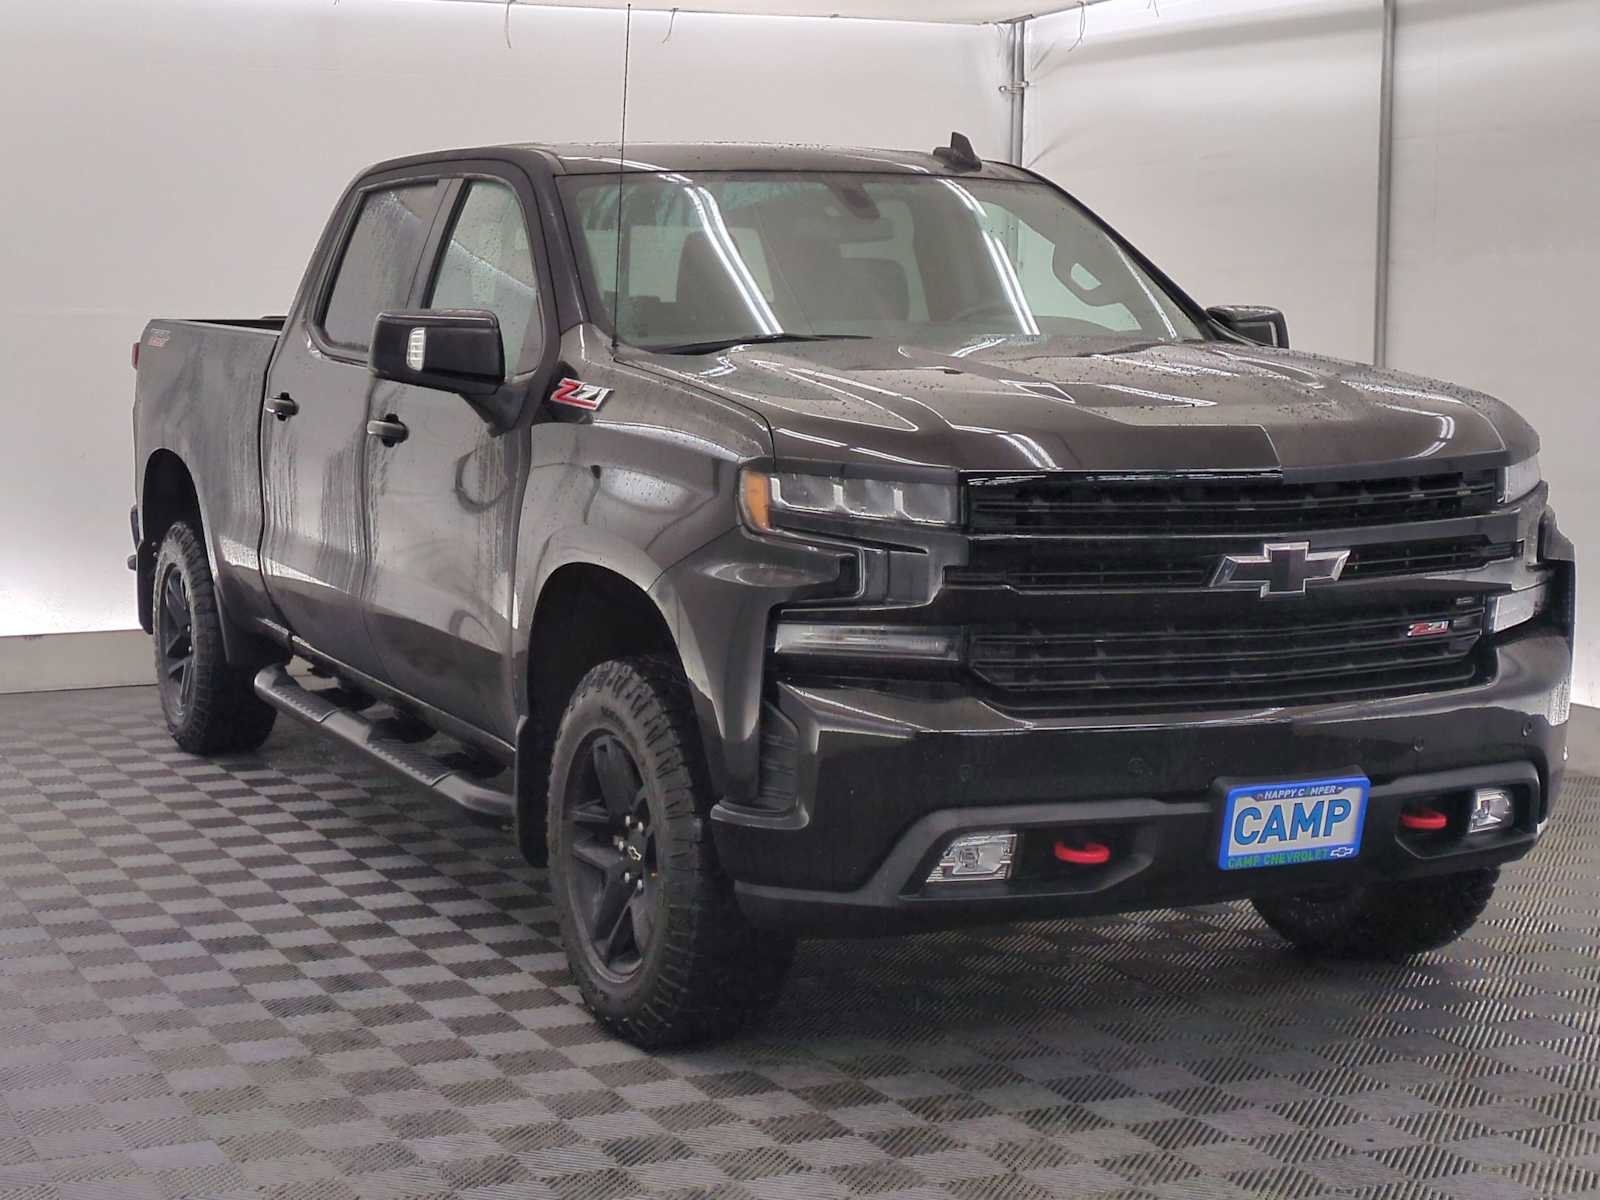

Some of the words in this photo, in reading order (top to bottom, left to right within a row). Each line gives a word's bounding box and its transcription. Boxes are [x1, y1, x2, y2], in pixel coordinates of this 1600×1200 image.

[550, 377, 614, 410] Z71
[1264, 788, 1296, 800] HAPPY
[1233, 798, 1352, 845] CAMP
[1228, 853, 1260, 870] CAMP
[1264, 848, 1328, 865] CHEVROLET
